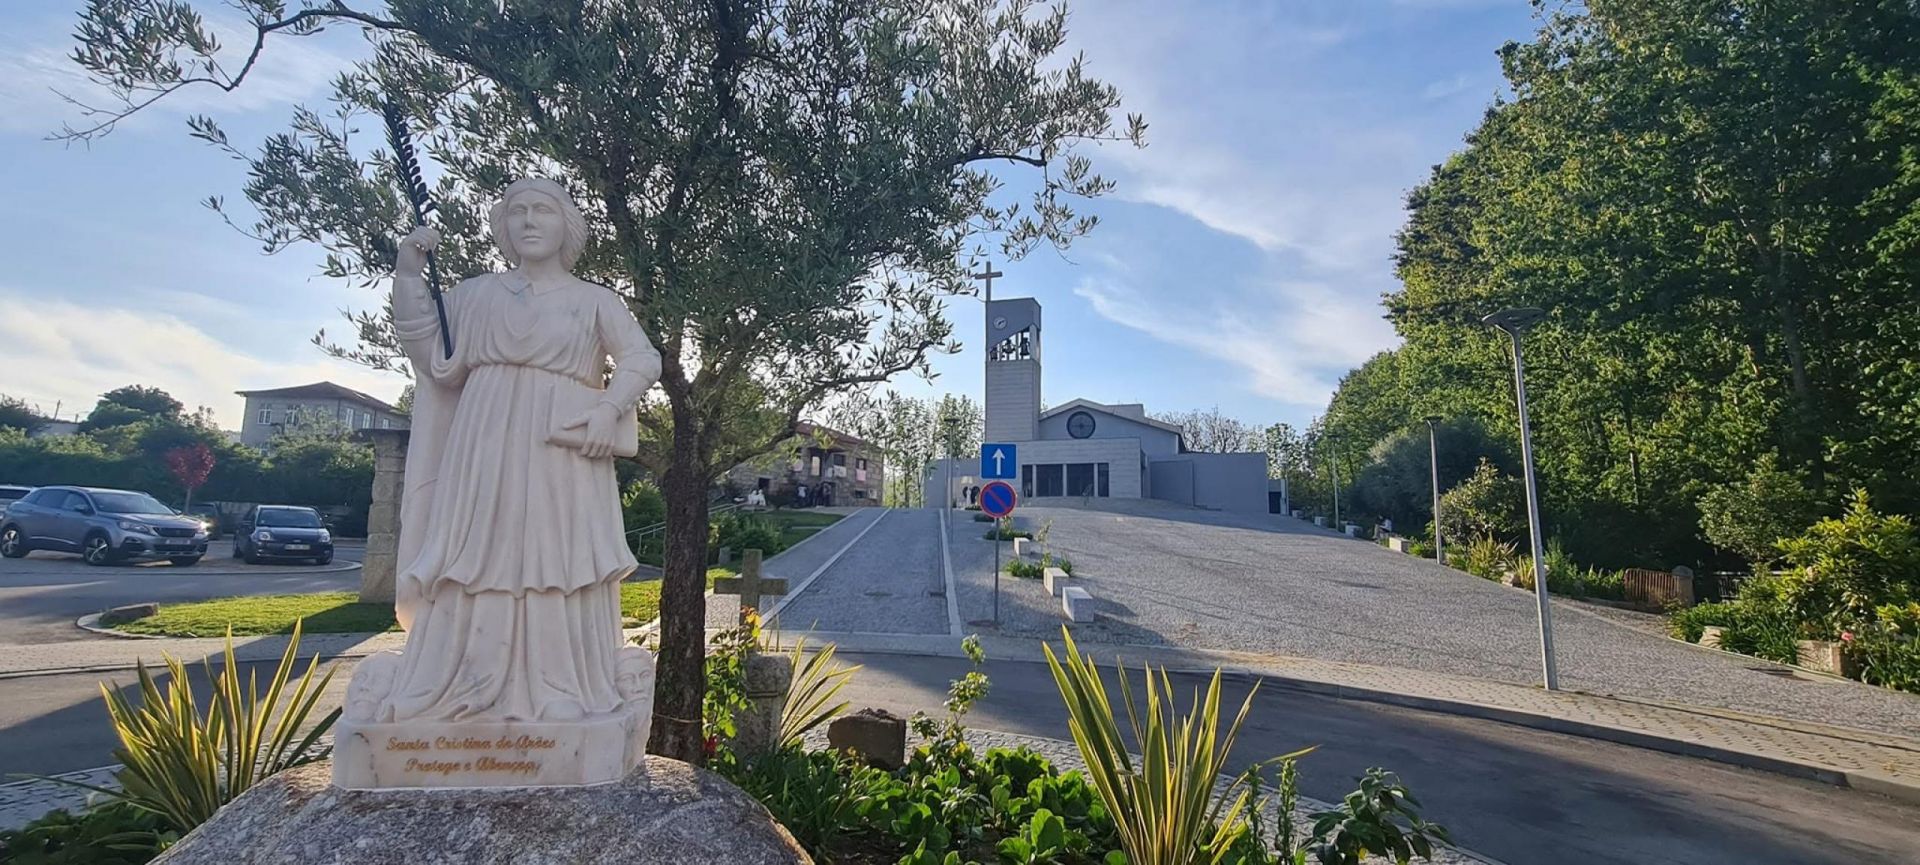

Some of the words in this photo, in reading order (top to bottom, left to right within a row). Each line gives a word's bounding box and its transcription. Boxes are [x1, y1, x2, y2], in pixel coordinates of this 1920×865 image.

[386, 736, 430, 750] Santa
[435, 735, 491, 749] Cristina
[495, 735, 513, 749] de
[404, 758, 460, 775] Protege
[463, 762, 472, 772] e
